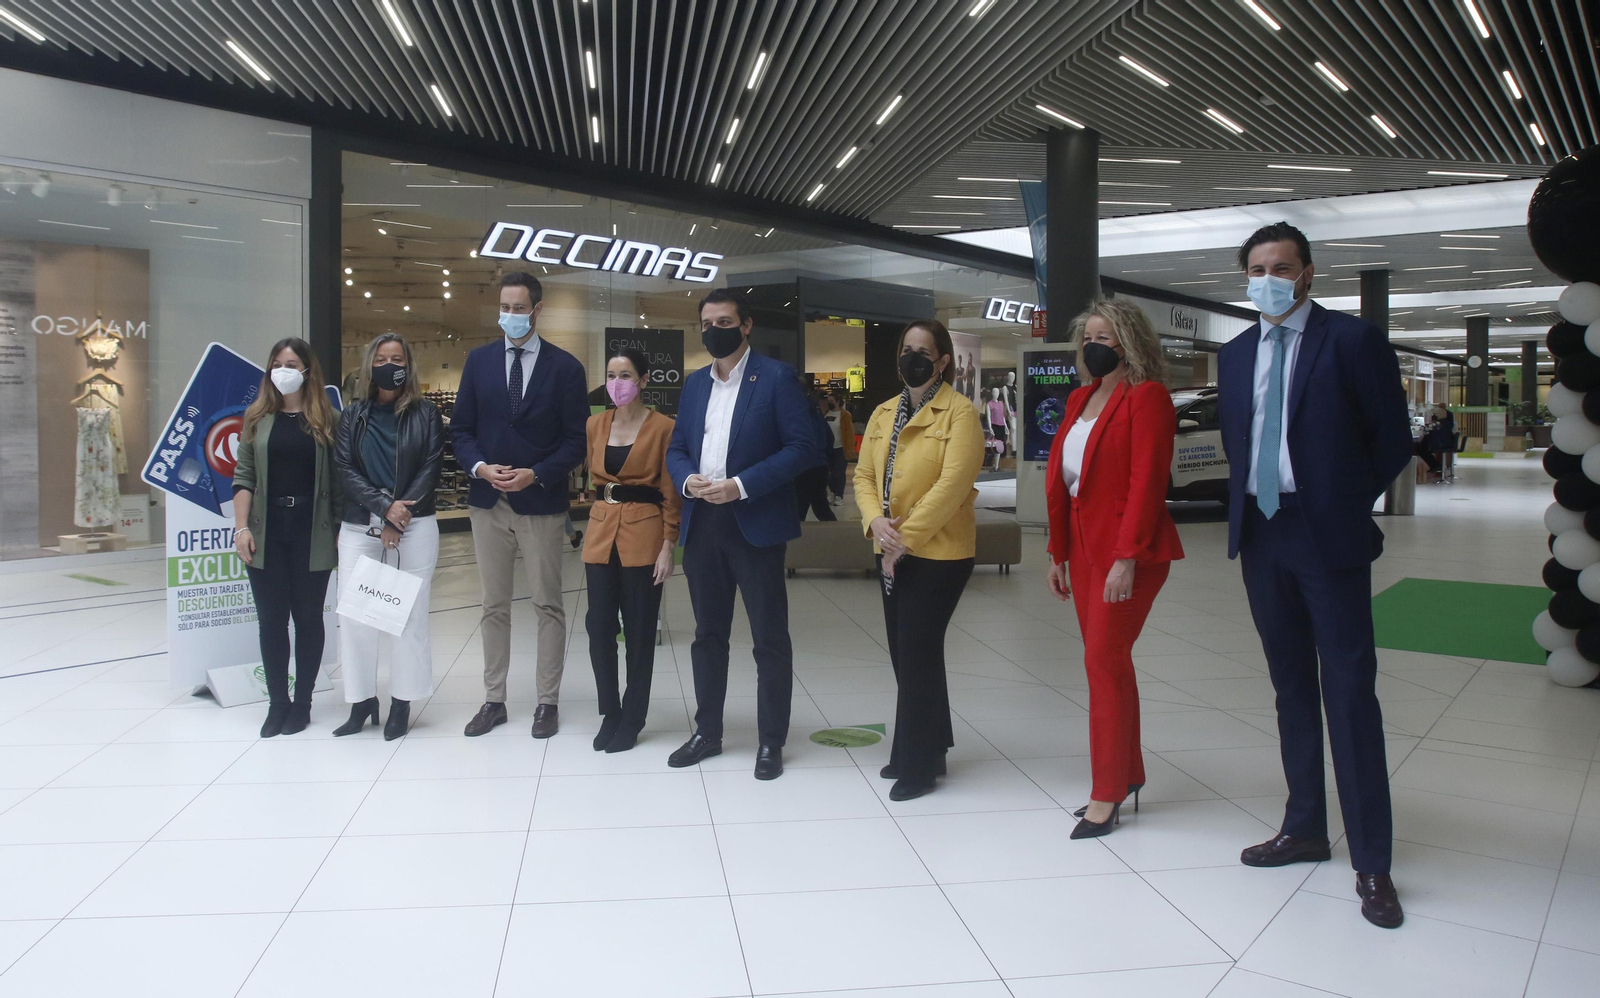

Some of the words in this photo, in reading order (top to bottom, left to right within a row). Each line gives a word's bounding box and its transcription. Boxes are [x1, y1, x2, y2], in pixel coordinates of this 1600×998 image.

[480, 221, 724, 283] DECIMAS
[609, 339, 646, 352] GRAN
[1047, 366, 1061, 375] DE
[1062, 365, 1076, 374] LA
[1033, 376, 1070, 384] TIERRA
[641, 391, 672, 406] BRIL
[149, 416, 195, 483] PASS
[1188, 452, 1216, 460] AIRCROSS
[1202, 459, 1229, 467] ENCHUFA
[177, 587, 208, 598] MUESTRA
[209, 586, 217, 594] TU
[219, 584, 244, 594] TARJETA
[245, 583, 250, 591] Y
[358, 584, 401, 606] MANGO
[178, 593, 243, 613] DESCUENTOS
[247, 592, 256, 604] E
[194, 621, 210, 629] PARA
[211, 617, 232, 627] SOCIOS
[232, 616, 243, 624] DEL
